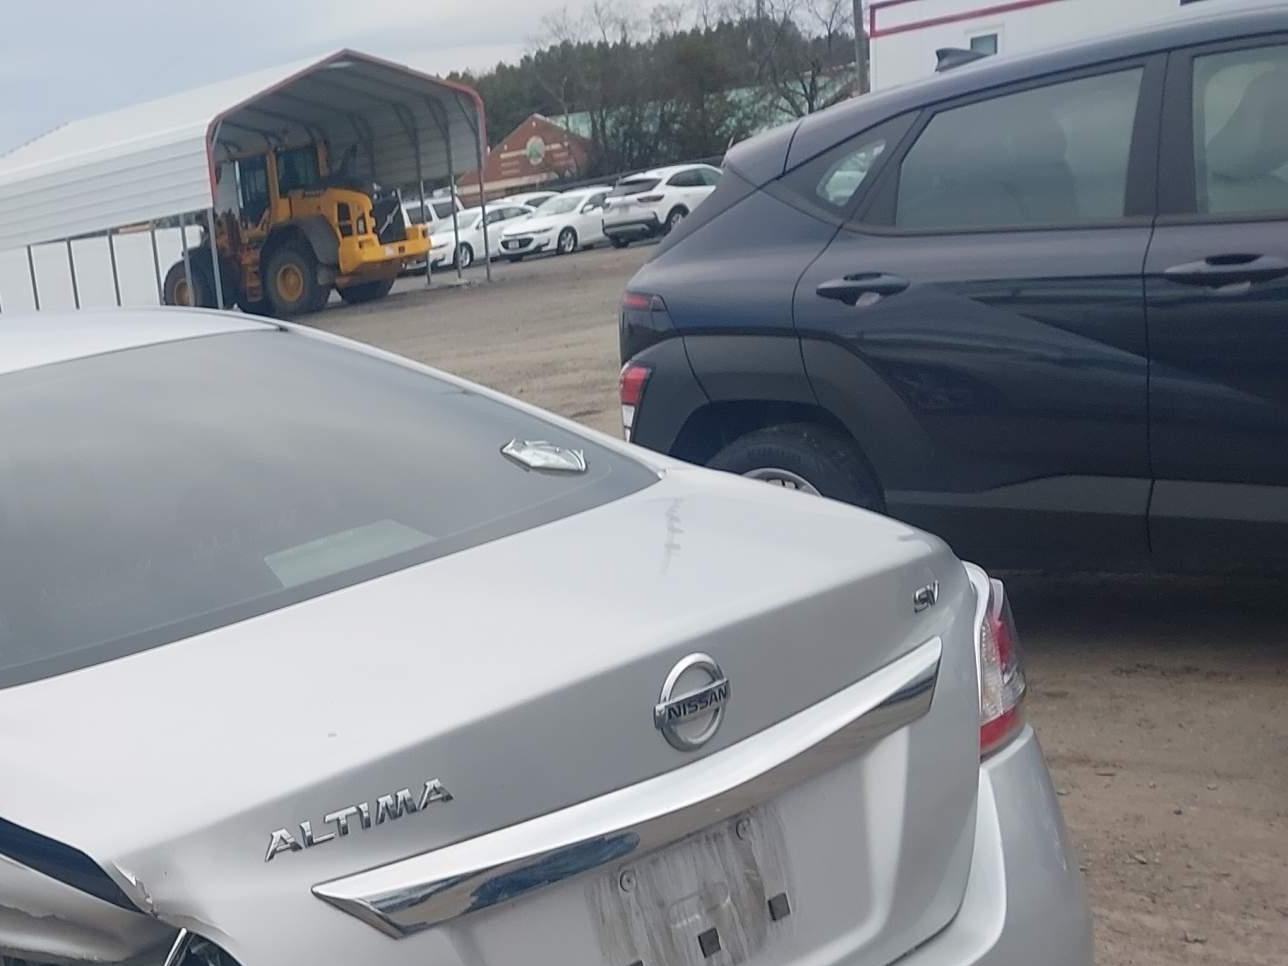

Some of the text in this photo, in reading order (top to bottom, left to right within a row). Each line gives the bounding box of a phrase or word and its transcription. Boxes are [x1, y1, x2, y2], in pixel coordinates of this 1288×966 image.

[914, 580, 940, 613] SV
[666, 684, 728, 720] NISSAN
[264, 778, 455, 863] ALTIMA
